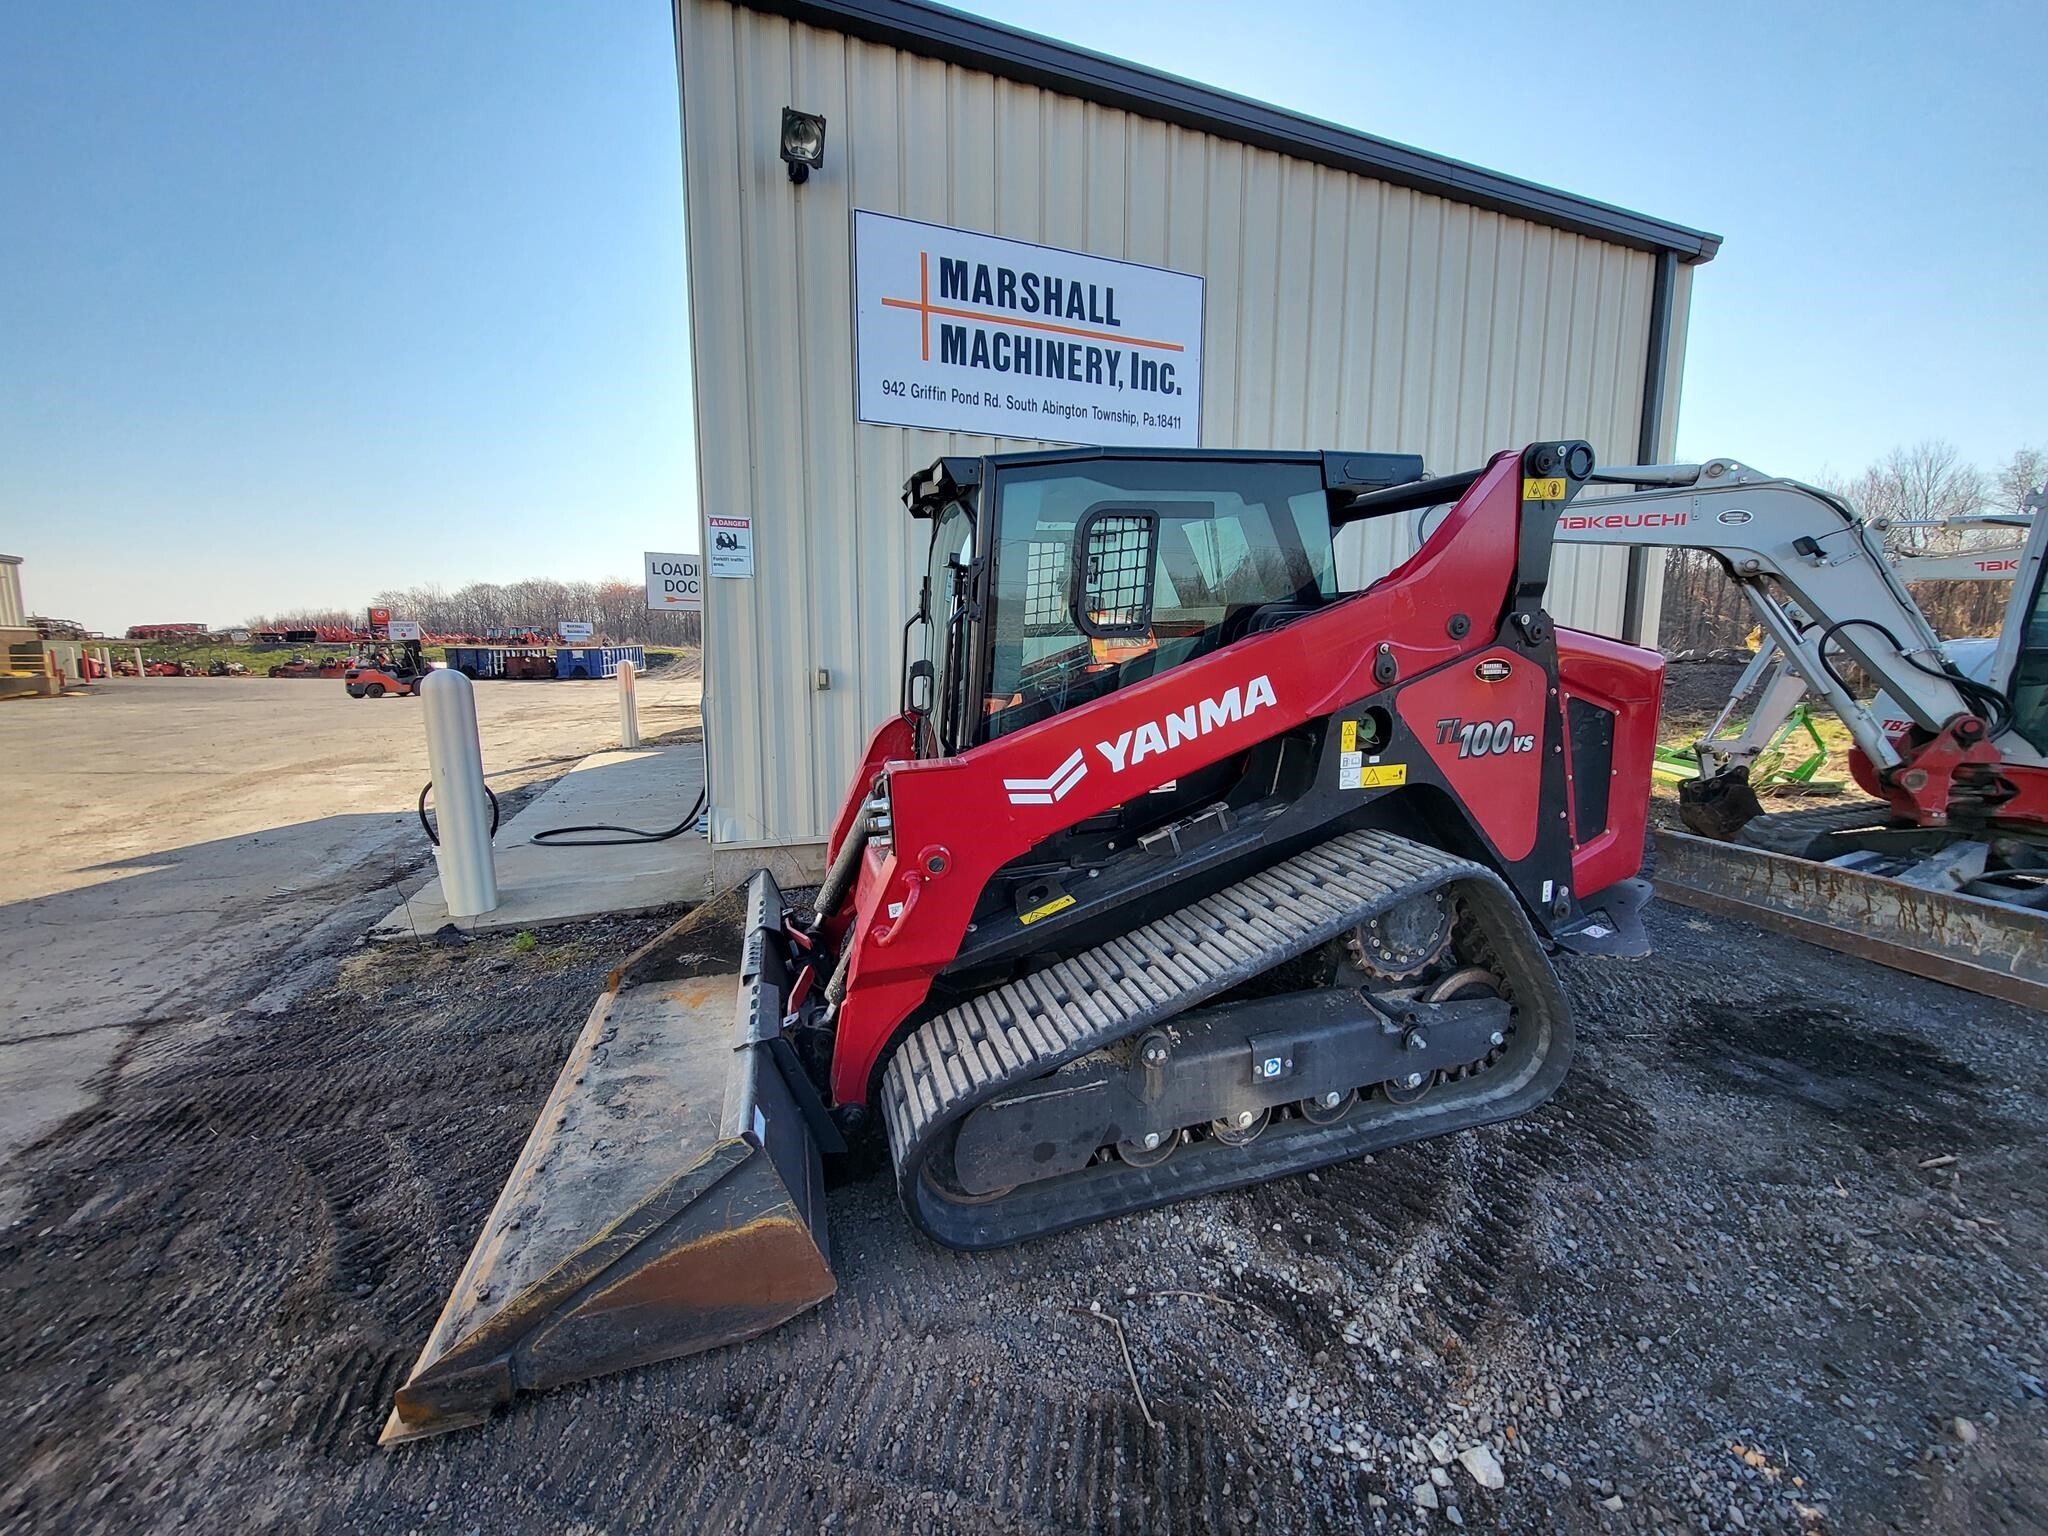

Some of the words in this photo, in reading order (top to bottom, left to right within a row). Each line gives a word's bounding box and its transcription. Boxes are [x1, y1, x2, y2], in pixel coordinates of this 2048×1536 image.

[939, 256, 1121, 327] MARSHALL
[940, 323, 1124, 392] MACHINERY,
[1130, 351, 1183, 396] Inc.
[882, 379, 906, 397] 942
[910, 383, 947, 402] Griffin
[951, 388, 980, 406] Pond
[984, 392, 1002, 409] Rd.
[1006, 395, 1038, 413] South
[1042, 399, 1088, 419] Abington
[1092, 405, 1140, 427] Township,
[1143, 412, 1182, 430] Pa.18411
[718, 519, 748, 528] DANGER
[652, 562, 701, 577] LOADI
[1974, 559, 2019, 572] TAK
[664, 579, 701, 594] DOC
[1096, 674, 1277, 773] YANMA
[1881, 720, 1914, 732] TB2
